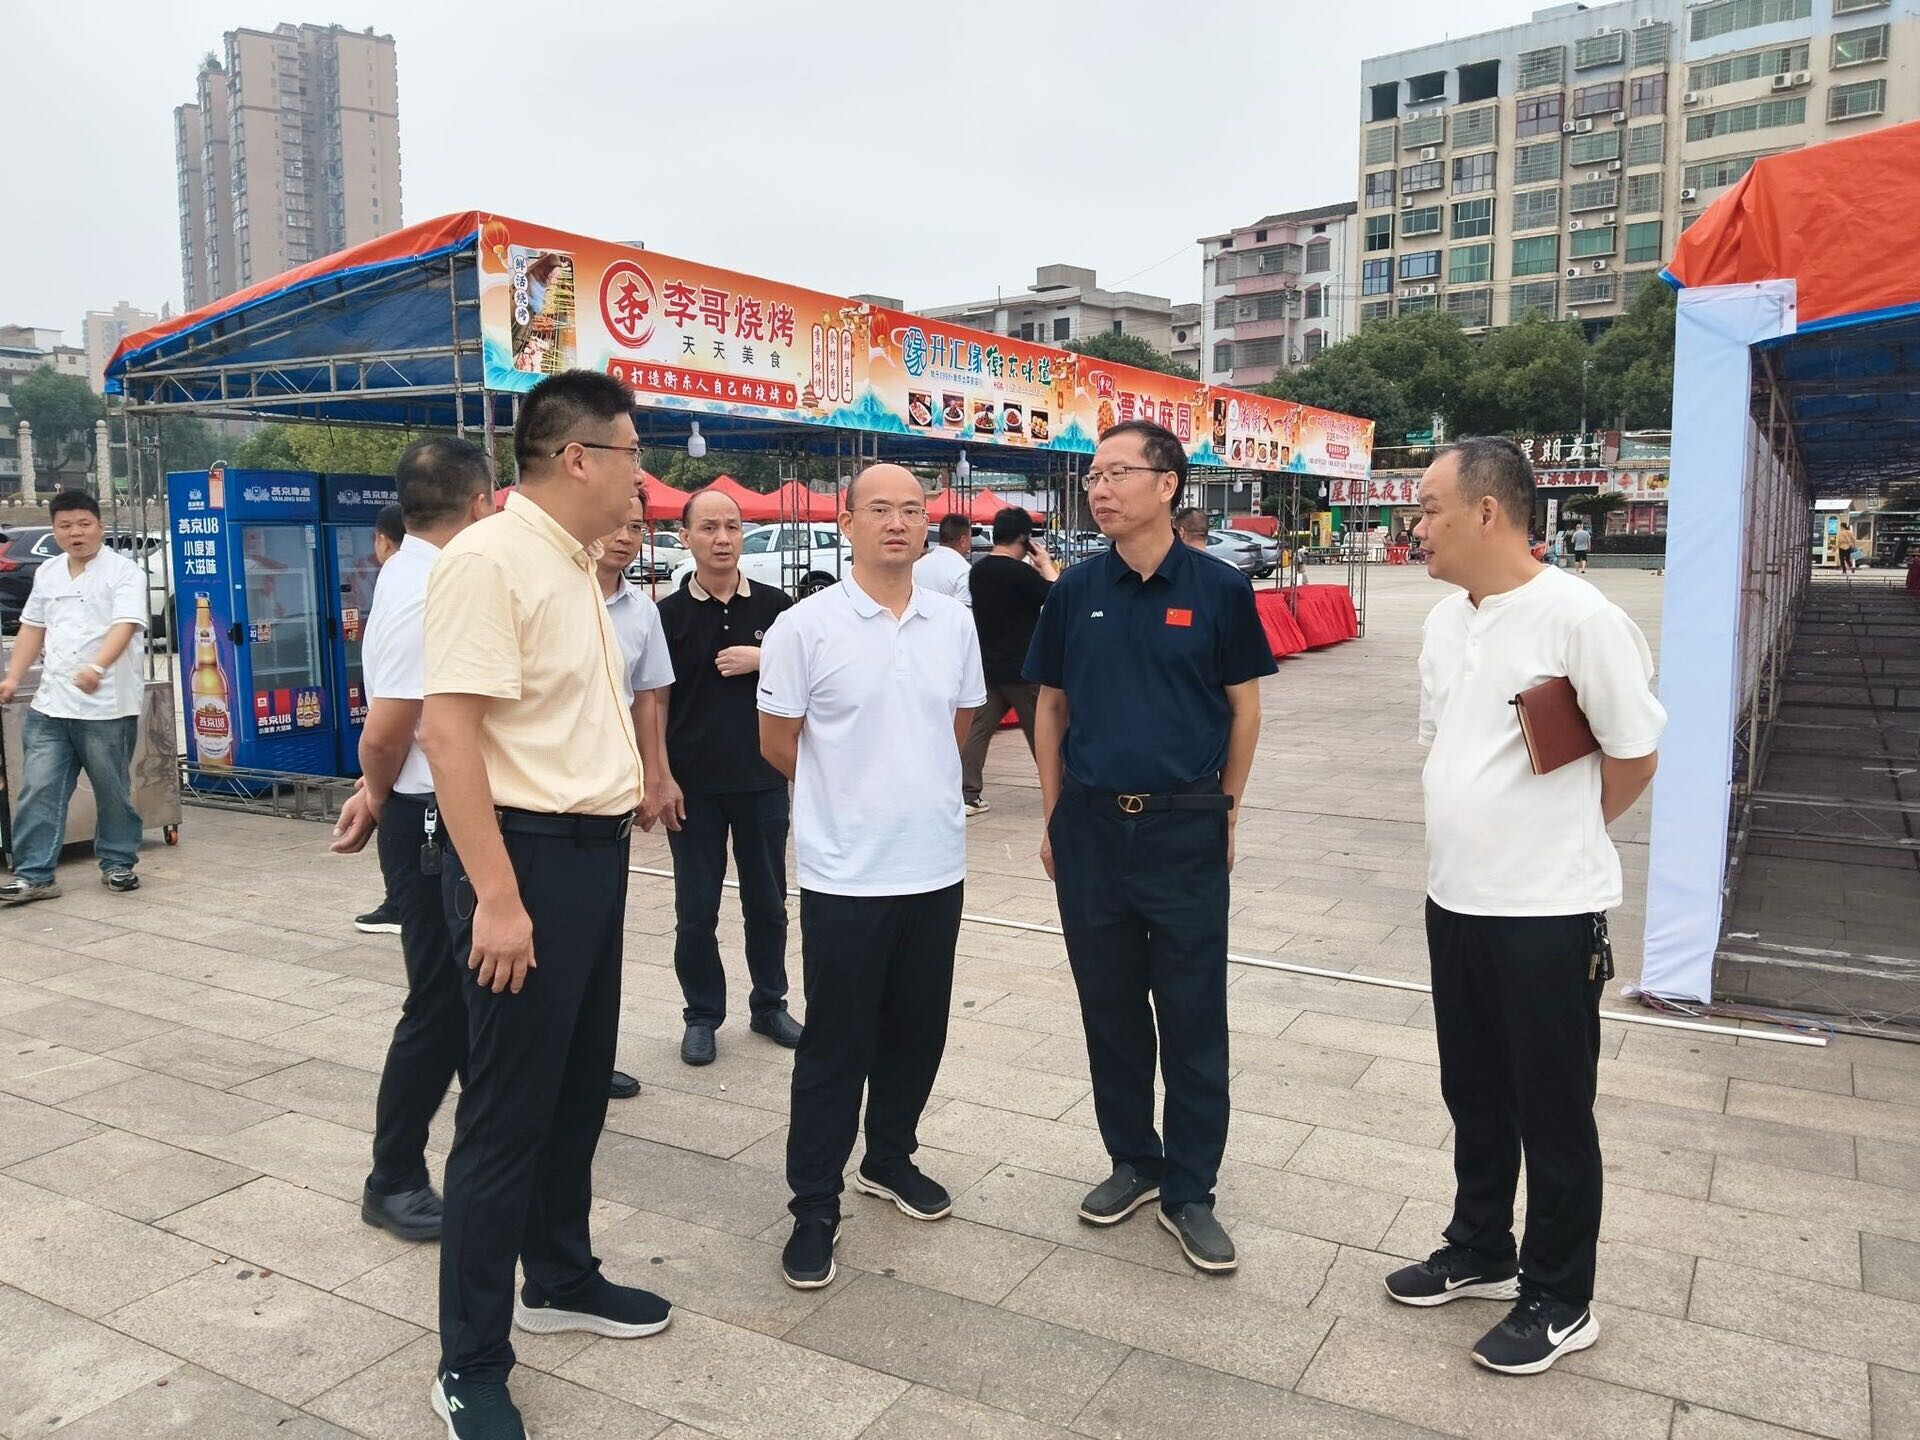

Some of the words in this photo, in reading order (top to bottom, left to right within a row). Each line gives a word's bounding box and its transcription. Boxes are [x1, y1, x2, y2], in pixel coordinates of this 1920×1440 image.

[515, 257, 528, 322] 鲜活烧烤
[612, 274, 651, 335] 李
[663, 280, 795, 348] 李哥烧烤
[682, 335, 782, 369] 天天美食
[985, 345, 1050, 387] 衡东味道
[630, 366, 781, 405] 打造衡东人自己的烧烤
[271, 487, 311, 496] 燕京啤酒
[1330, 479, 1415, 503] 星期五夜宵
[178, 517, 219, 534] 燕京U8
[184, 540, 216, 556] 小度酒
[185, 559, 217, 575] 大滋味
[200, 716, 225, 729] 燕京U8
[257, 713, 292, 726] 燕京U8
